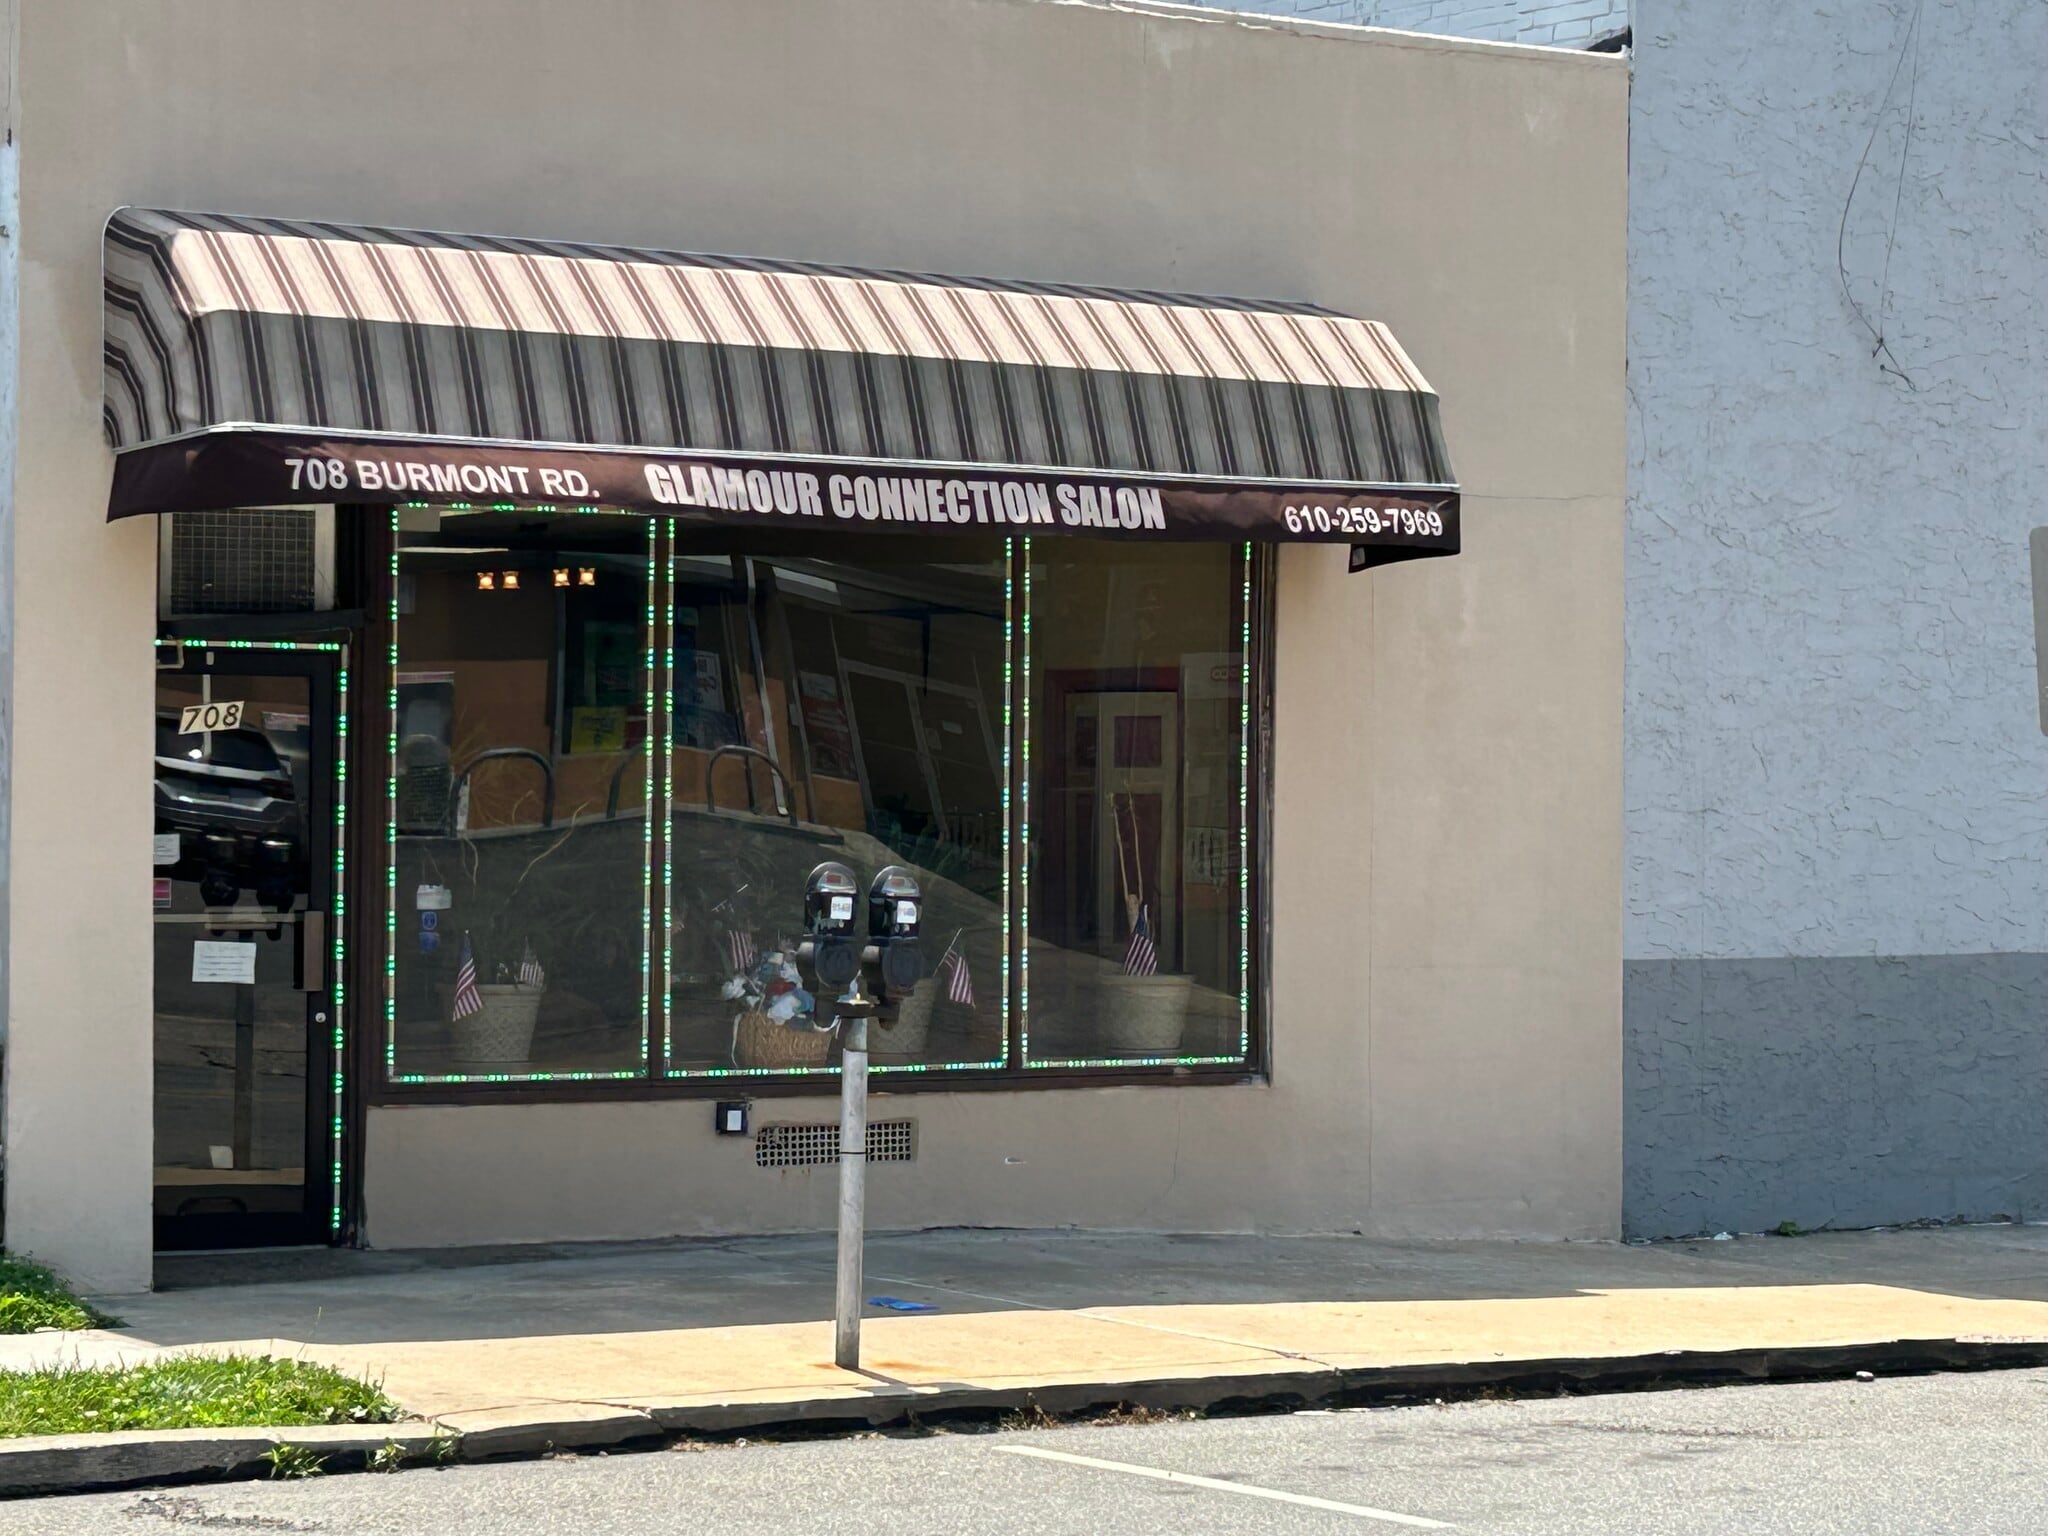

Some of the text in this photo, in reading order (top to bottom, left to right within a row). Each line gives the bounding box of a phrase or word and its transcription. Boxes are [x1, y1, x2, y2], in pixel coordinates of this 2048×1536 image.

[285, 459, 601, 498] 708 BURMONT RD.
[643, 463, 1167, 530] GLAMOUR CONNECTION SALON
[1284, 506, 1443, 536] 610-259-7969
[185, 704, 239, 732] 708
